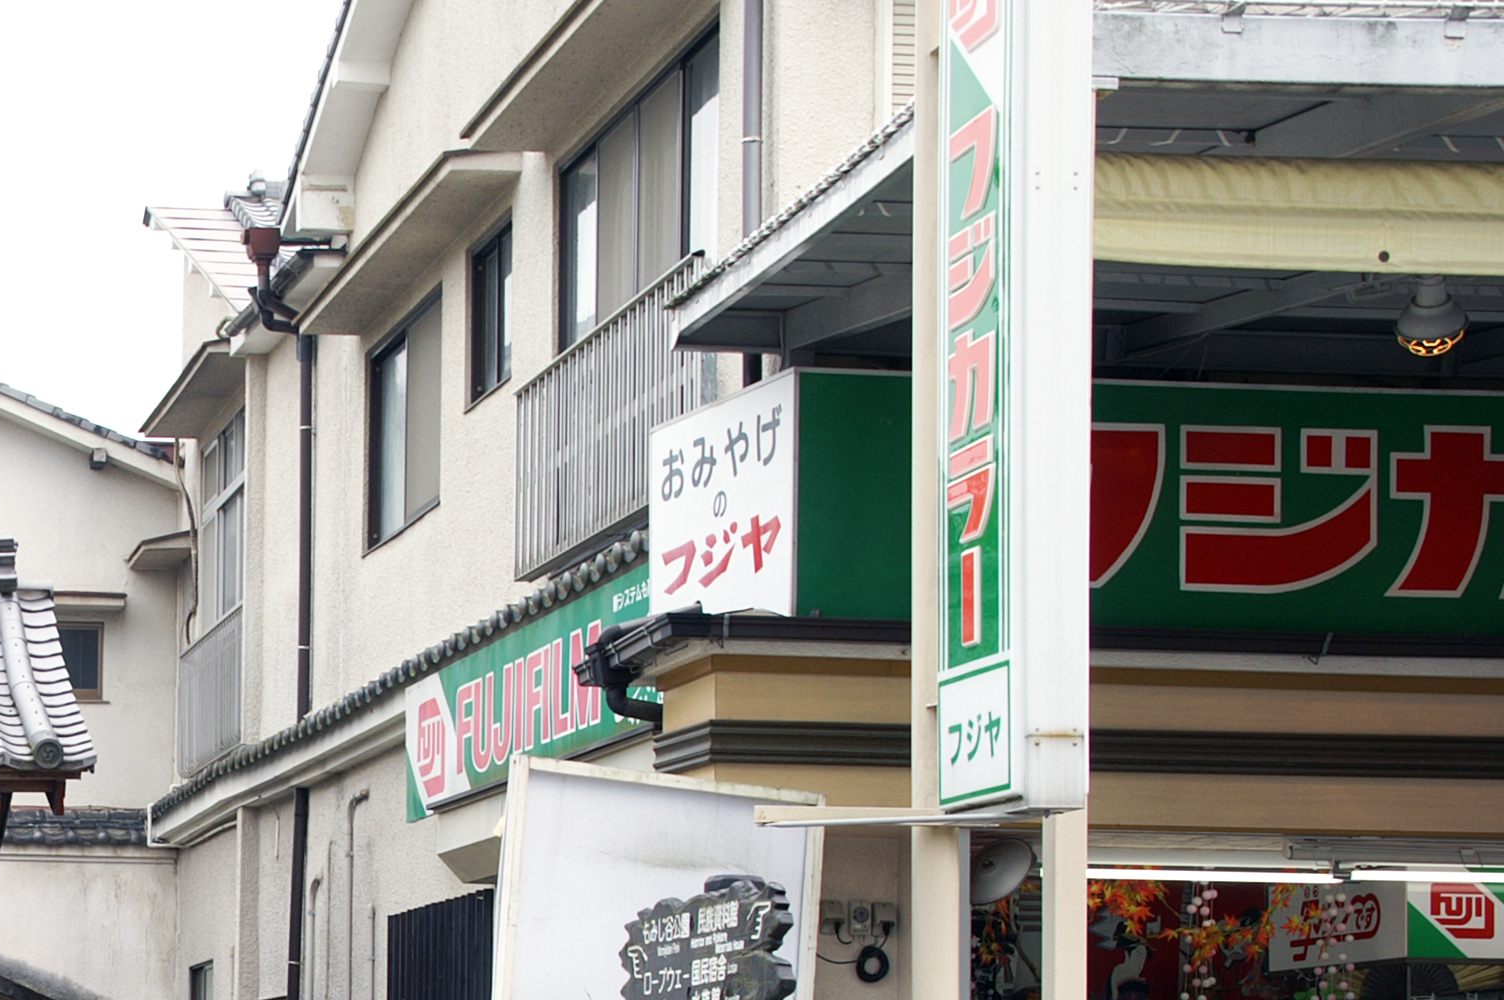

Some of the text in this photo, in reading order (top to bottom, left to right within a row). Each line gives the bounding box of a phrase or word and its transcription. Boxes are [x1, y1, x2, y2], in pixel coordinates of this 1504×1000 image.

[947, 104, 998, 648] フジカラー
[661, 403, 782, 502] おみやげ
[713, 490, 728, 518] の
[661, 515, 782, 595] フジヤ
[455, 618, 602, 776] FUJIFILM
[948, 711, 1001, 767] フジヤ
[642, 912, 690, 944] もみじ谷公園
[1429, 882, 1495, 940] FUJI
